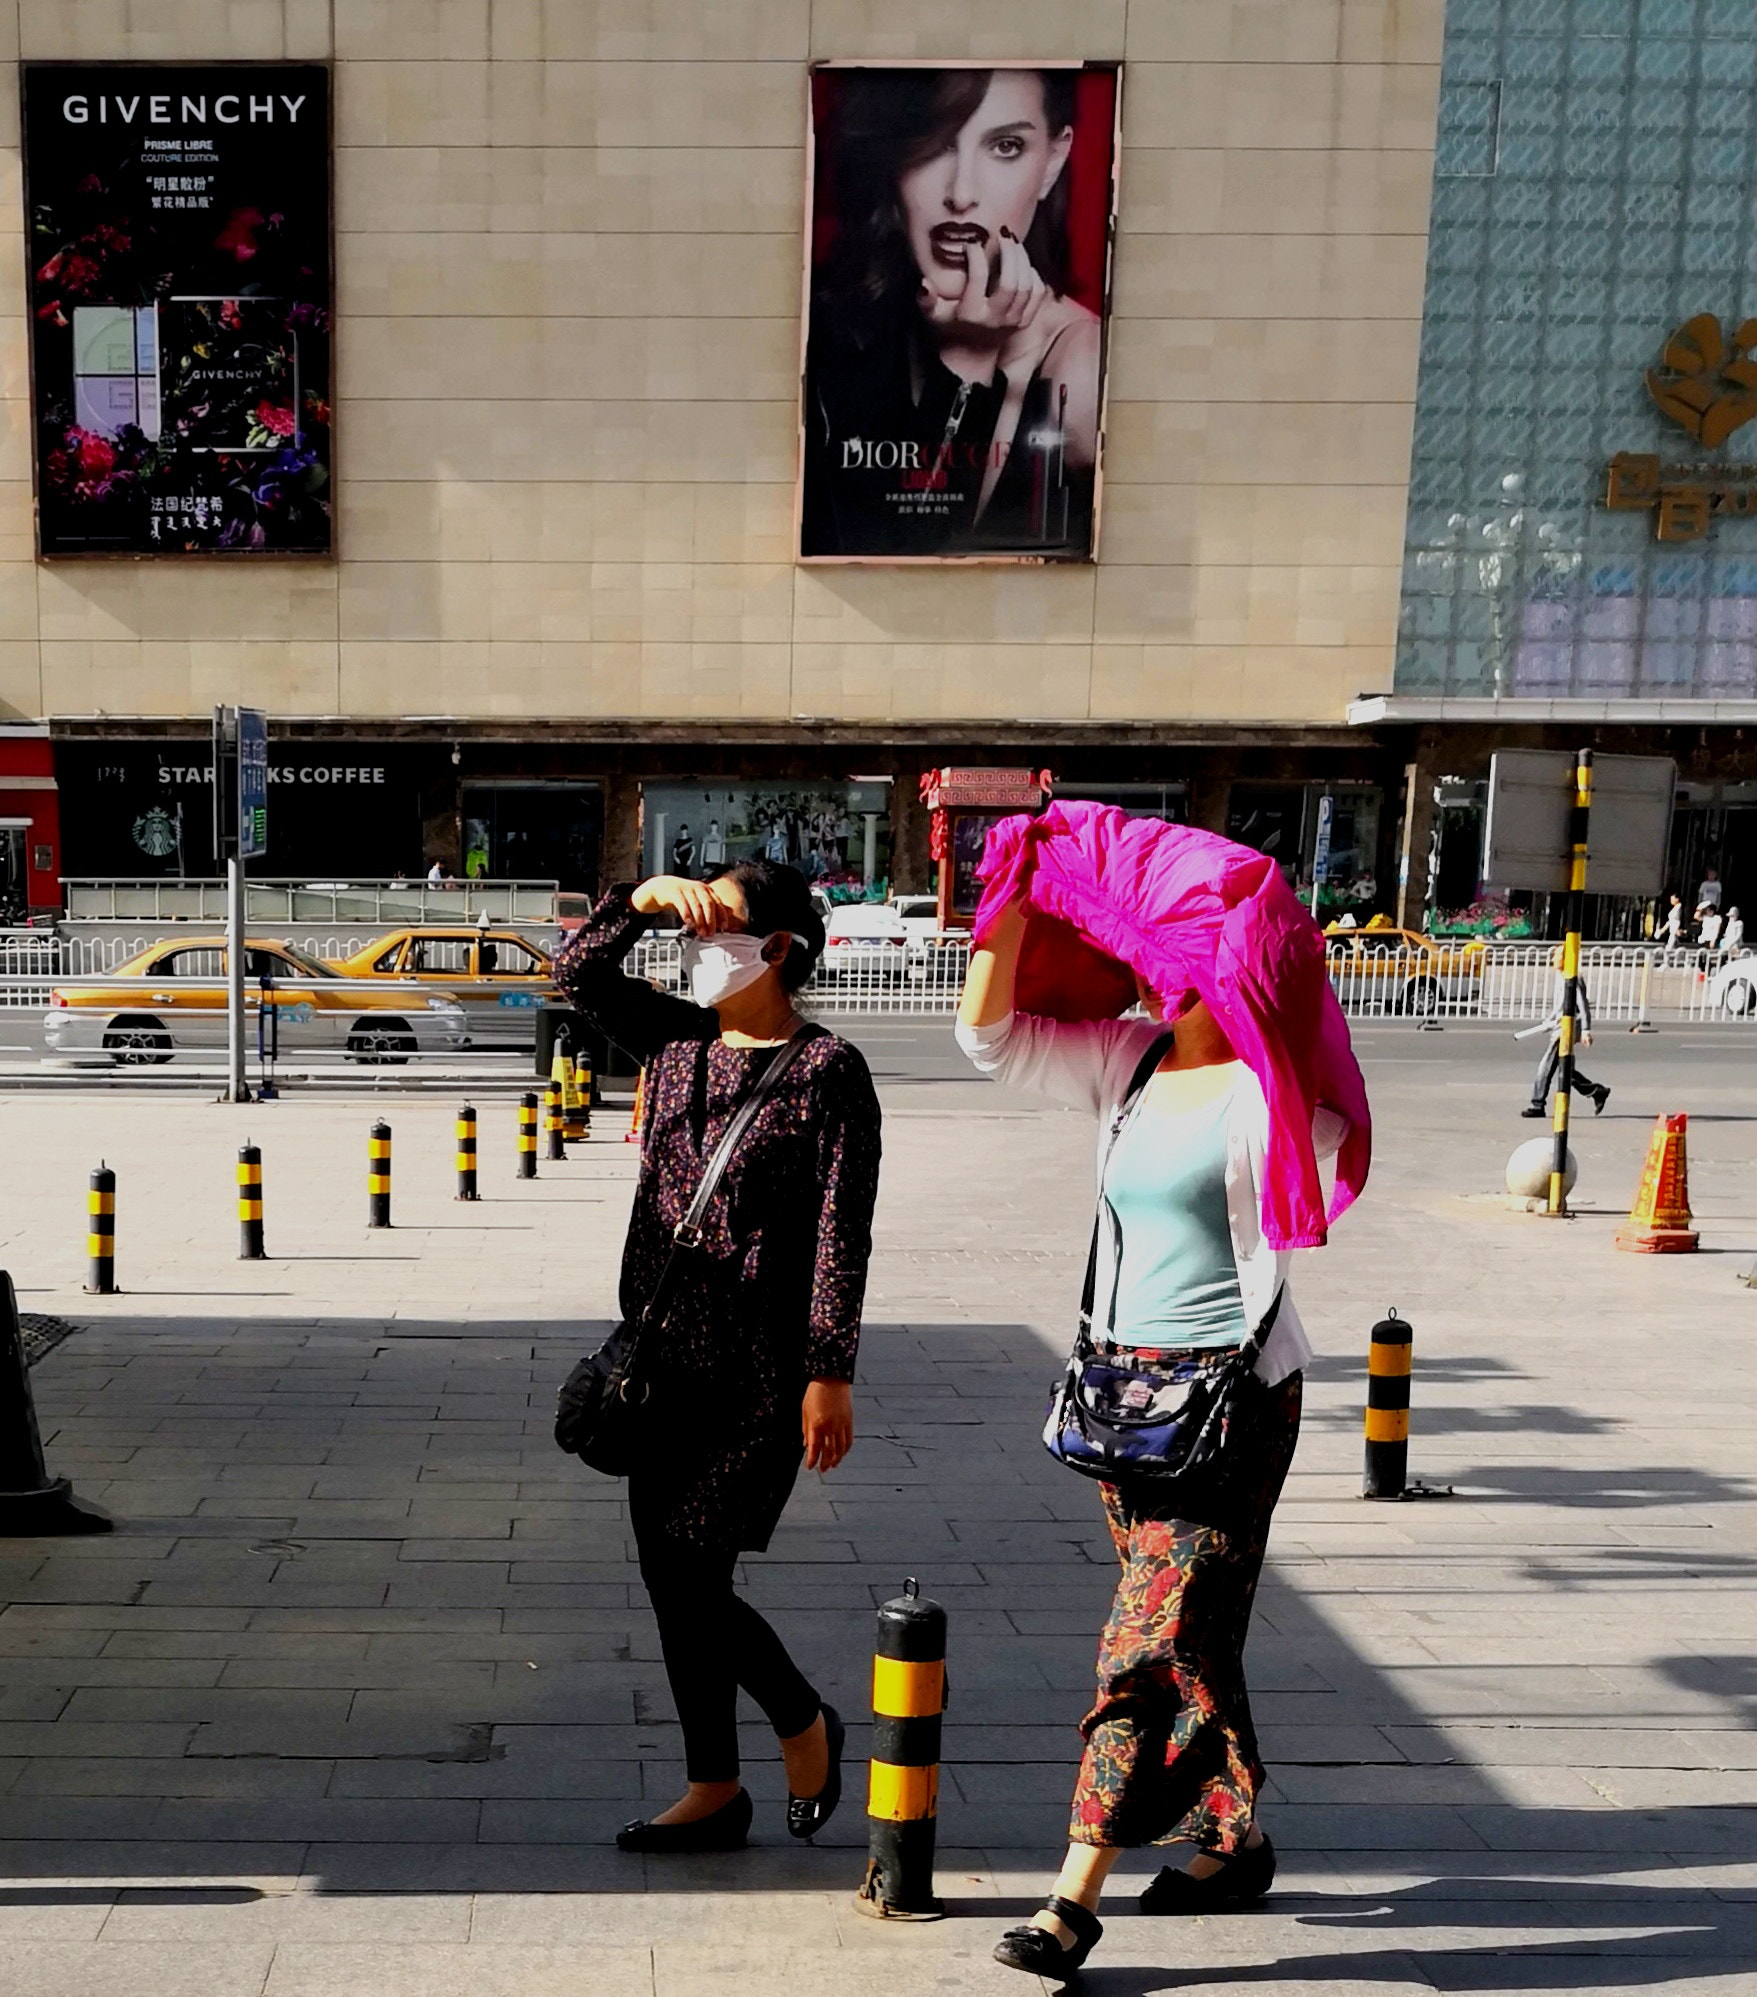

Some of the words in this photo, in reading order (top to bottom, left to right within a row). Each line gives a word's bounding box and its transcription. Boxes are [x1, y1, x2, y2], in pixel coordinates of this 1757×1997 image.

[62, 95, 307, 124] GIVENCHY
[144, 140, 182, 150] PRISME
[184, 140, 213, 150] LIBRE
[192, 370, 262, 379] GIVENCHY
[158, 767, 295, 783] STARKS
[299, 767, 385, 783] COFFEE
